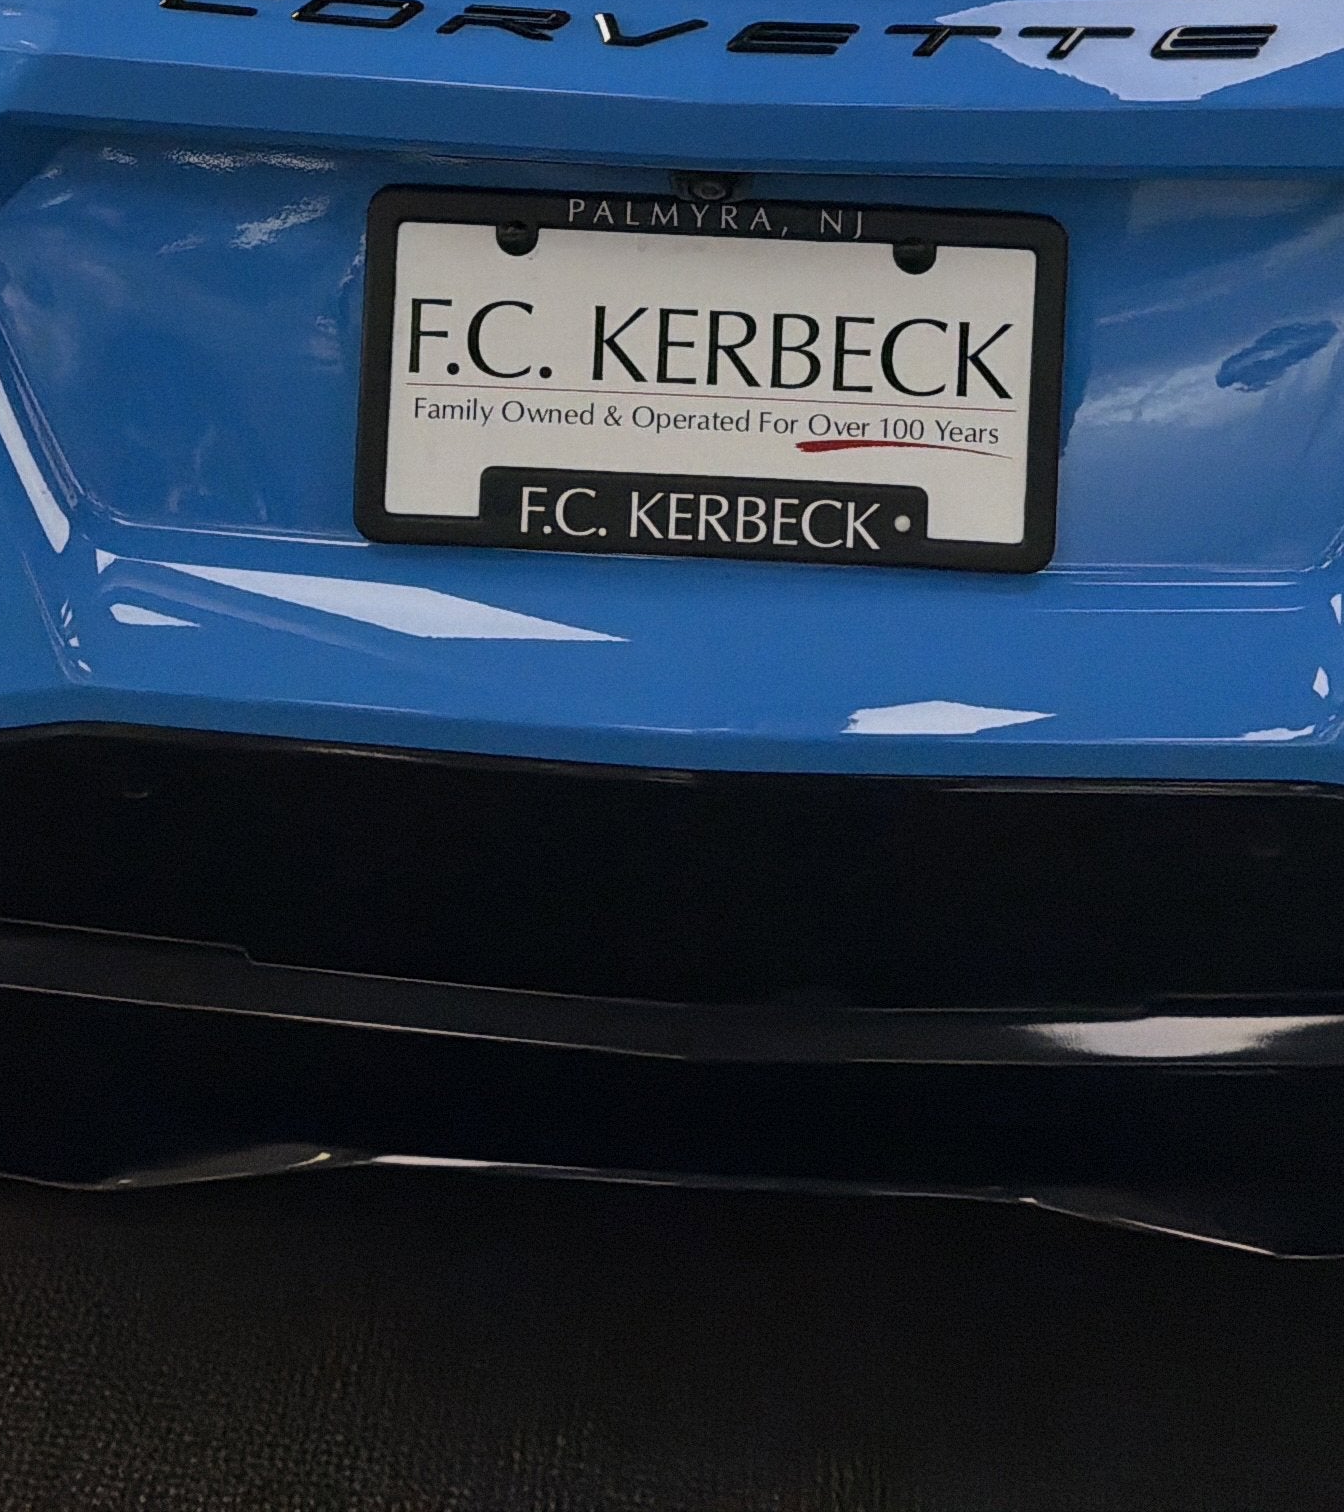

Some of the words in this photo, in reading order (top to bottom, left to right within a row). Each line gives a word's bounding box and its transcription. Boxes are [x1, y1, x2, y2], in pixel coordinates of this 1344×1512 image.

[567, 198, 790, 238] PALMYRA,
[820, 208, 866, 239] NJ
[408, 298, 553, 380] F.C.
[591, 304, 1014, 400] KERBECK
[414, 397, 493, 427] Family
[502, 399, 595, 427] Owned
[604, 404, 623, 427] &
[632, 405, 750, 434] Operated
[759, 410, 798, 435] For
[808, 413, 870, 439] Over
[880, 417, 924, 440] 100
[935, 419, 999, 445] Years
[520, 487, 607, 537] F.C.
[628, 490, 881, 550] KERBECK
